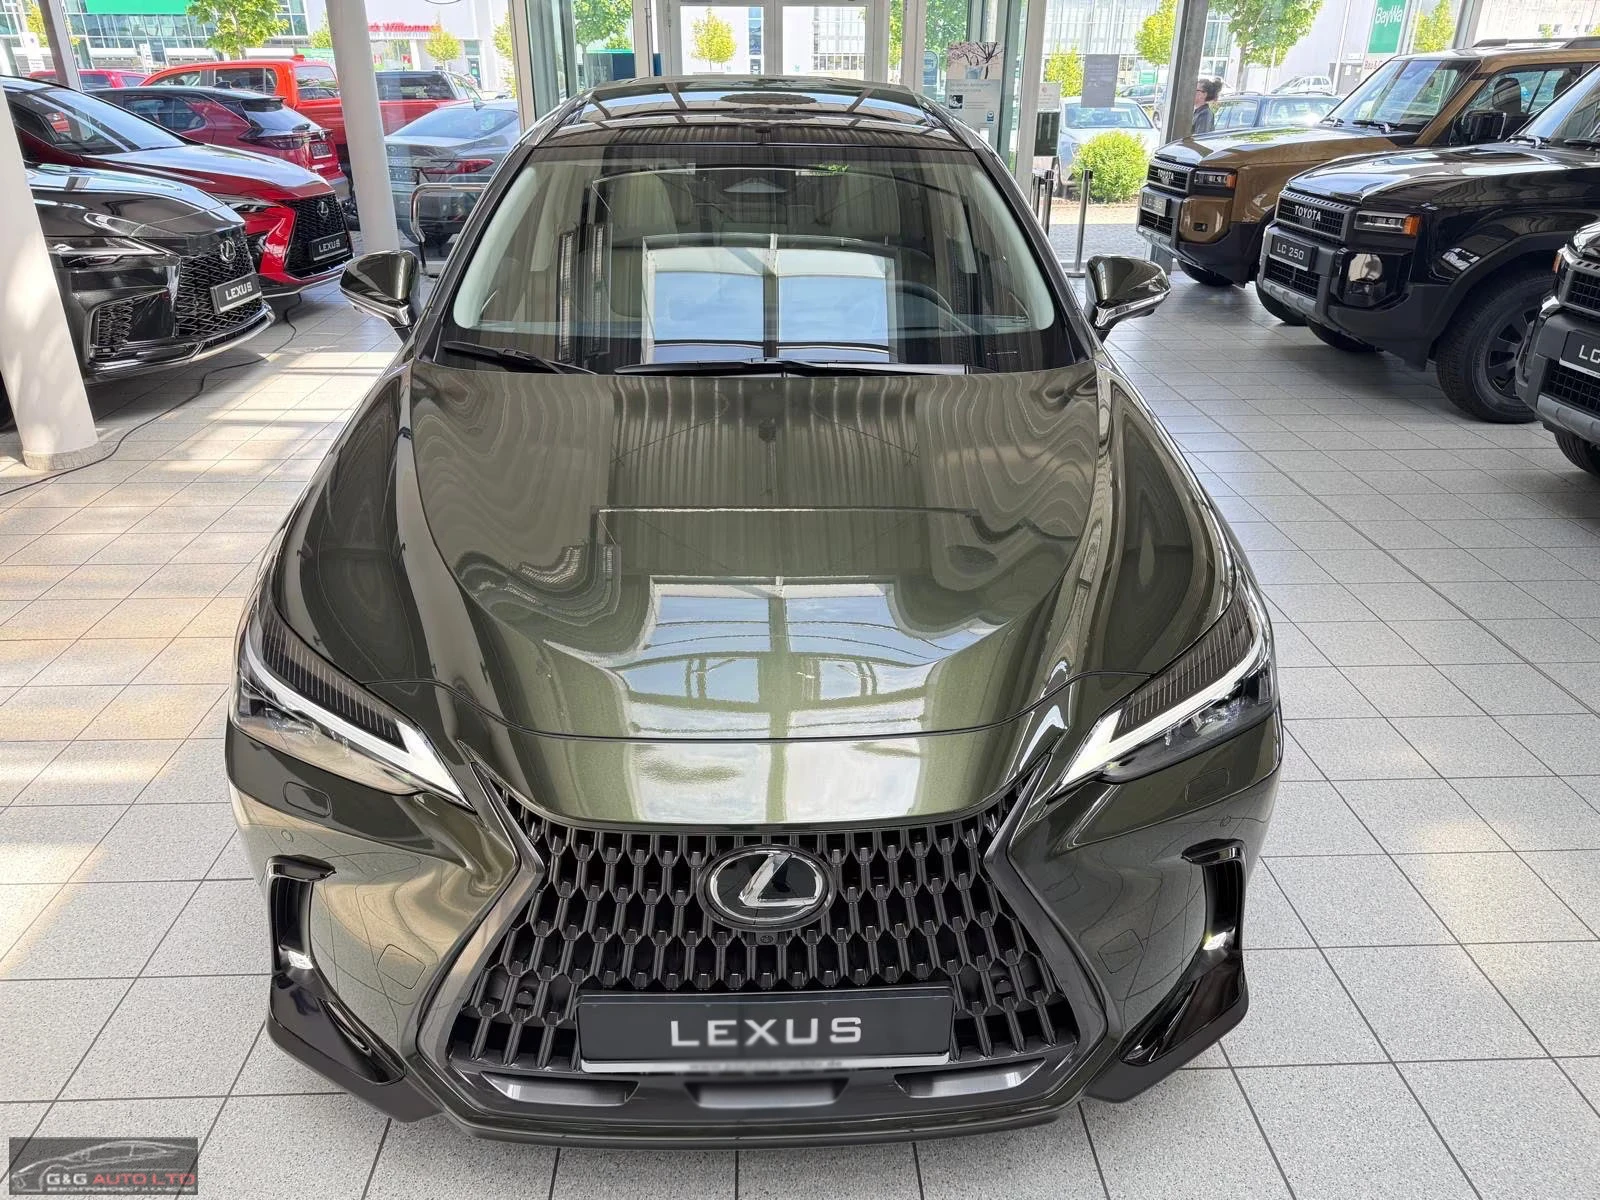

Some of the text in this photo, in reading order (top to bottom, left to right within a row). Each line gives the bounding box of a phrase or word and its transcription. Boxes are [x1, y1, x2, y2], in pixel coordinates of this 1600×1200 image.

[1375, 5, 1403, 28] BayWa
[1294, 205, 1321, 222] TOYOTA
[318, 238, 341, 253] LEXUS
[1277, 242, 1305, 260] LC 250
[225, 281, 253, 301] LEXUS
[670, 1016, 862, 1047] LEXUS
